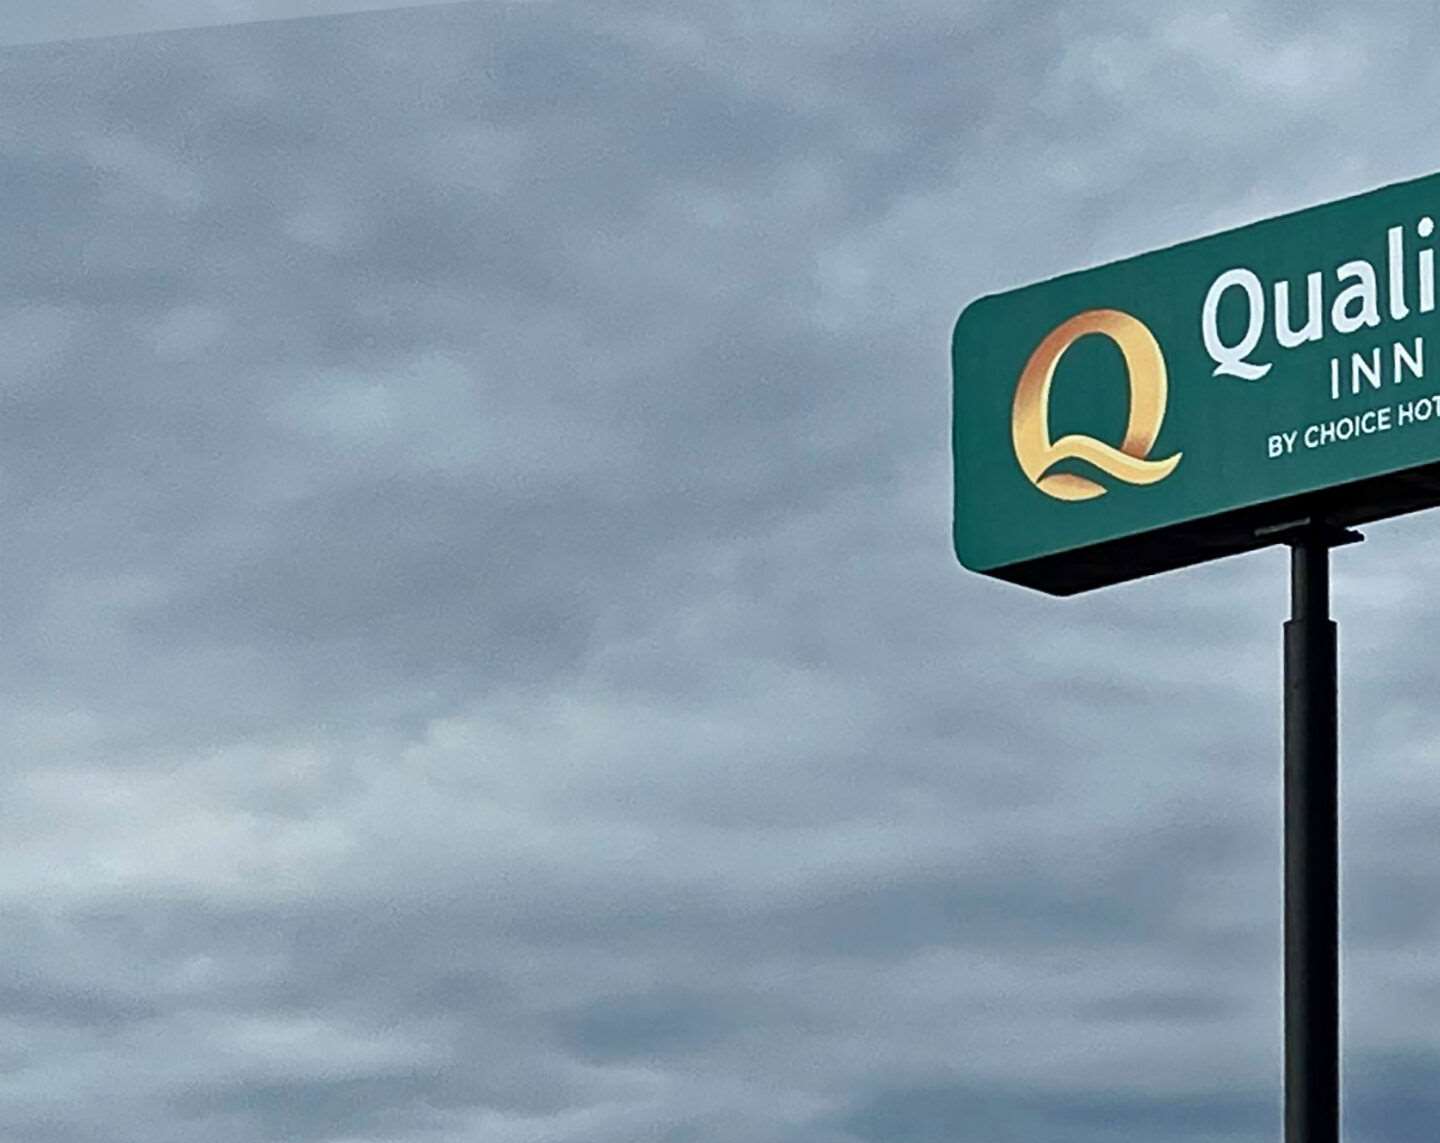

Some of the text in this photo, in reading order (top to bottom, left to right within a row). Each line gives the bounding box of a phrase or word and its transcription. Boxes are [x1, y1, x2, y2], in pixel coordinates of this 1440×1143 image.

[1330, 336, 1424, 400] INN
[1011, 308, 1183, 501] Q
[1267, 431, 1298, 458] BY
[1303, 407, 1392, 449] CHOICE
